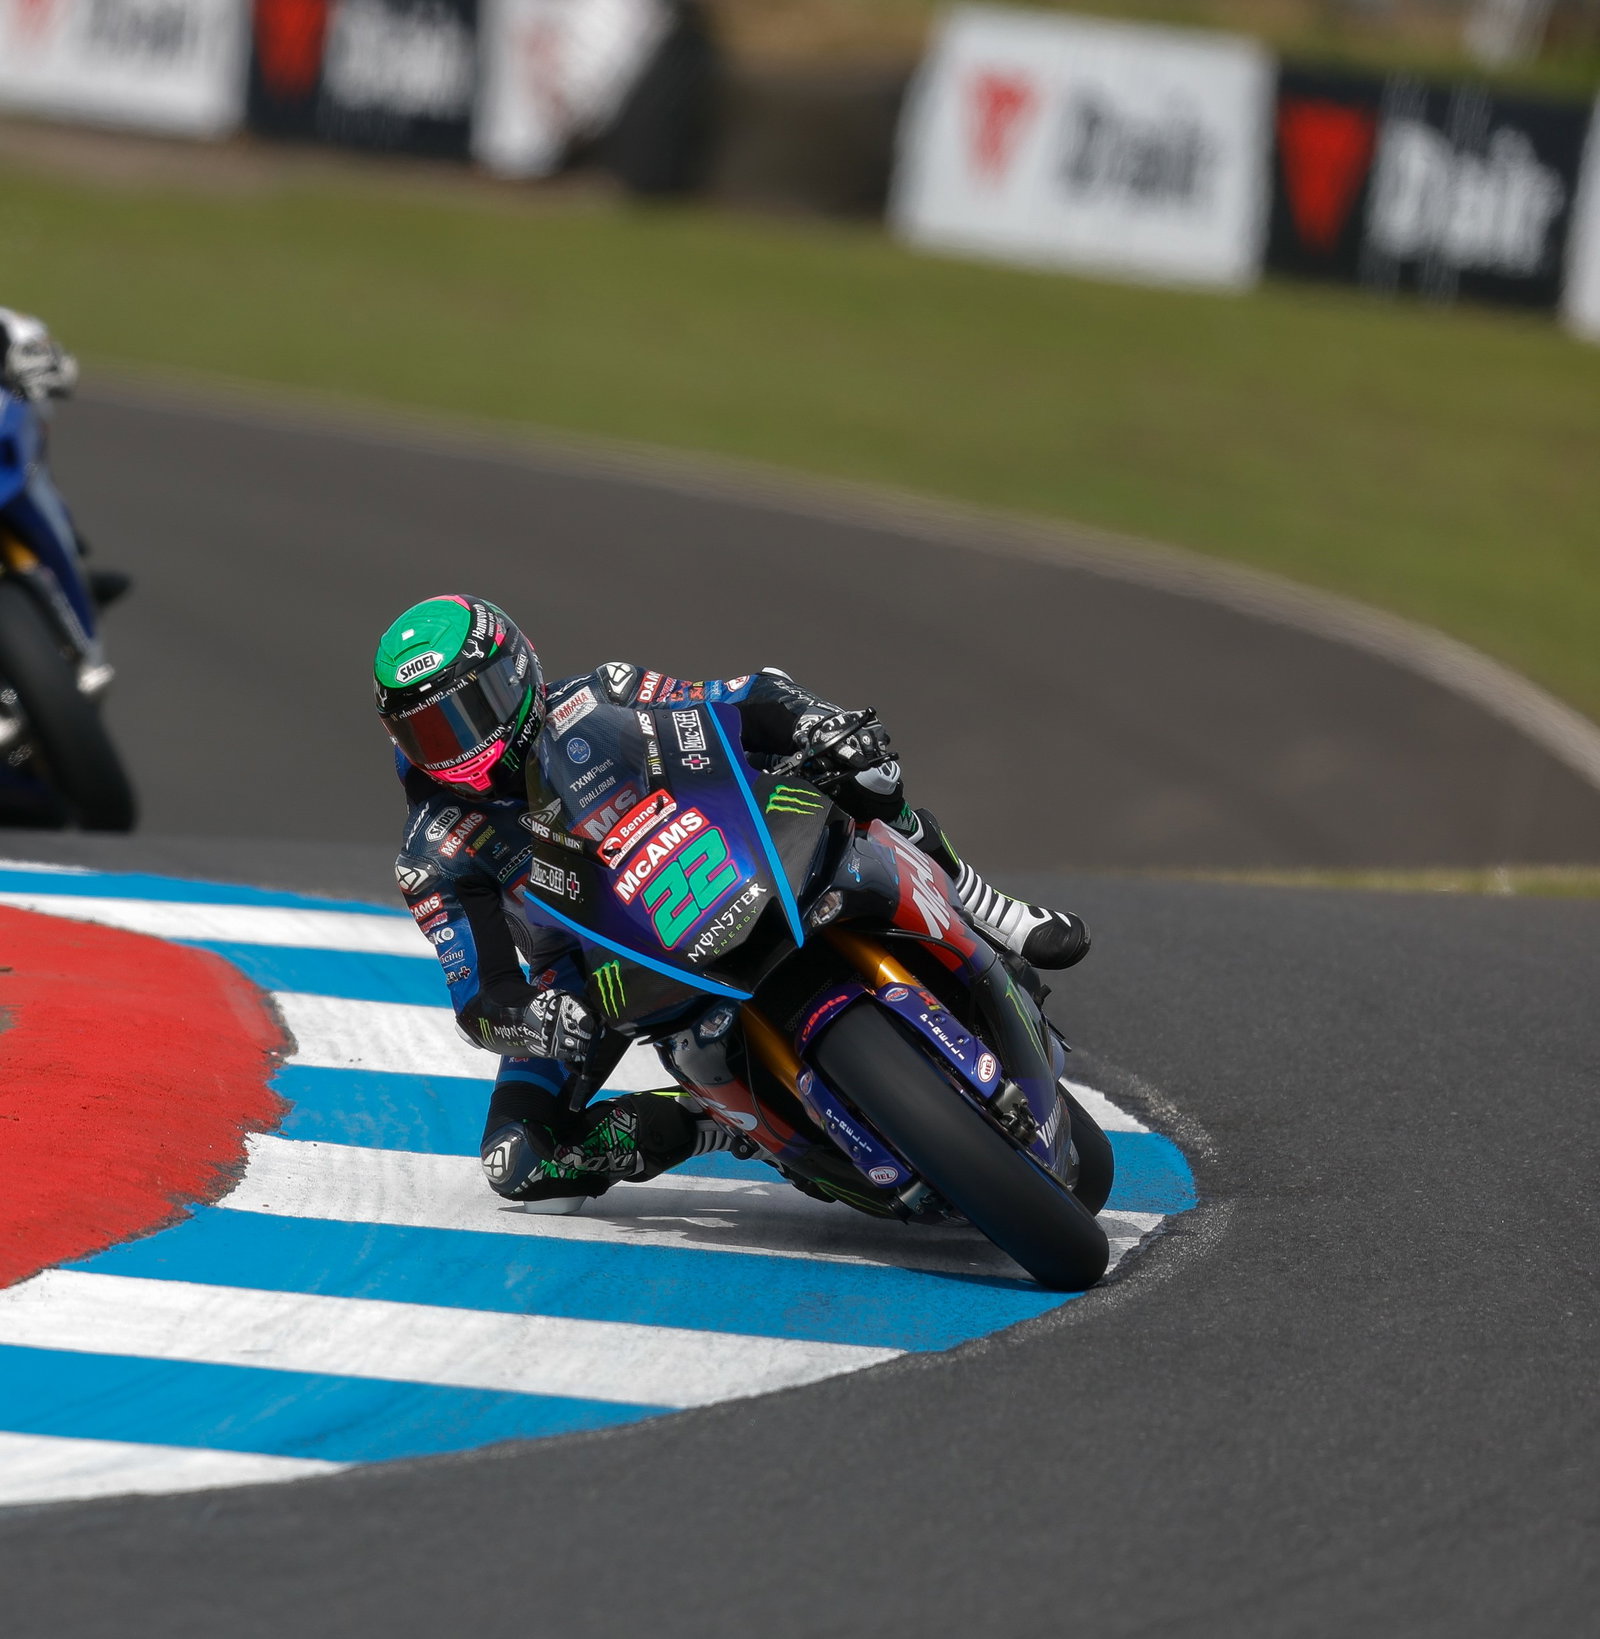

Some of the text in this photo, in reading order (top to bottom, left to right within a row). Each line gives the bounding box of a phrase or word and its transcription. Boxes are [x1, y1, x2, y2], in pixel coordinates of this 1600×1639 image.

[400, 655, 436, 681] SHOEI
[516, 654, 527, 676] SHOEI
[553, 691, 589, 723] YAMAHA
[461, 725, 507, 763] DISTINCTION
[676, 712, 703, 750] Muc-Off
[430, 809, 457, 837] SHOEI
[440, 812, 484, 856] McAMS
[616, 811, 703, 901] McAMS
[532, 861, 563, 892] Muc-Off
[641, 827, 740, 949] 22
[410, 896, 440, 919] AMS
[687, 882, 768, 963] MONSTER
[712, 907, 758, 955] ENERGY
[919, 1013, 965, 1061] PIRELLI
[825, 1108, 872, 1153] PIRELLI
